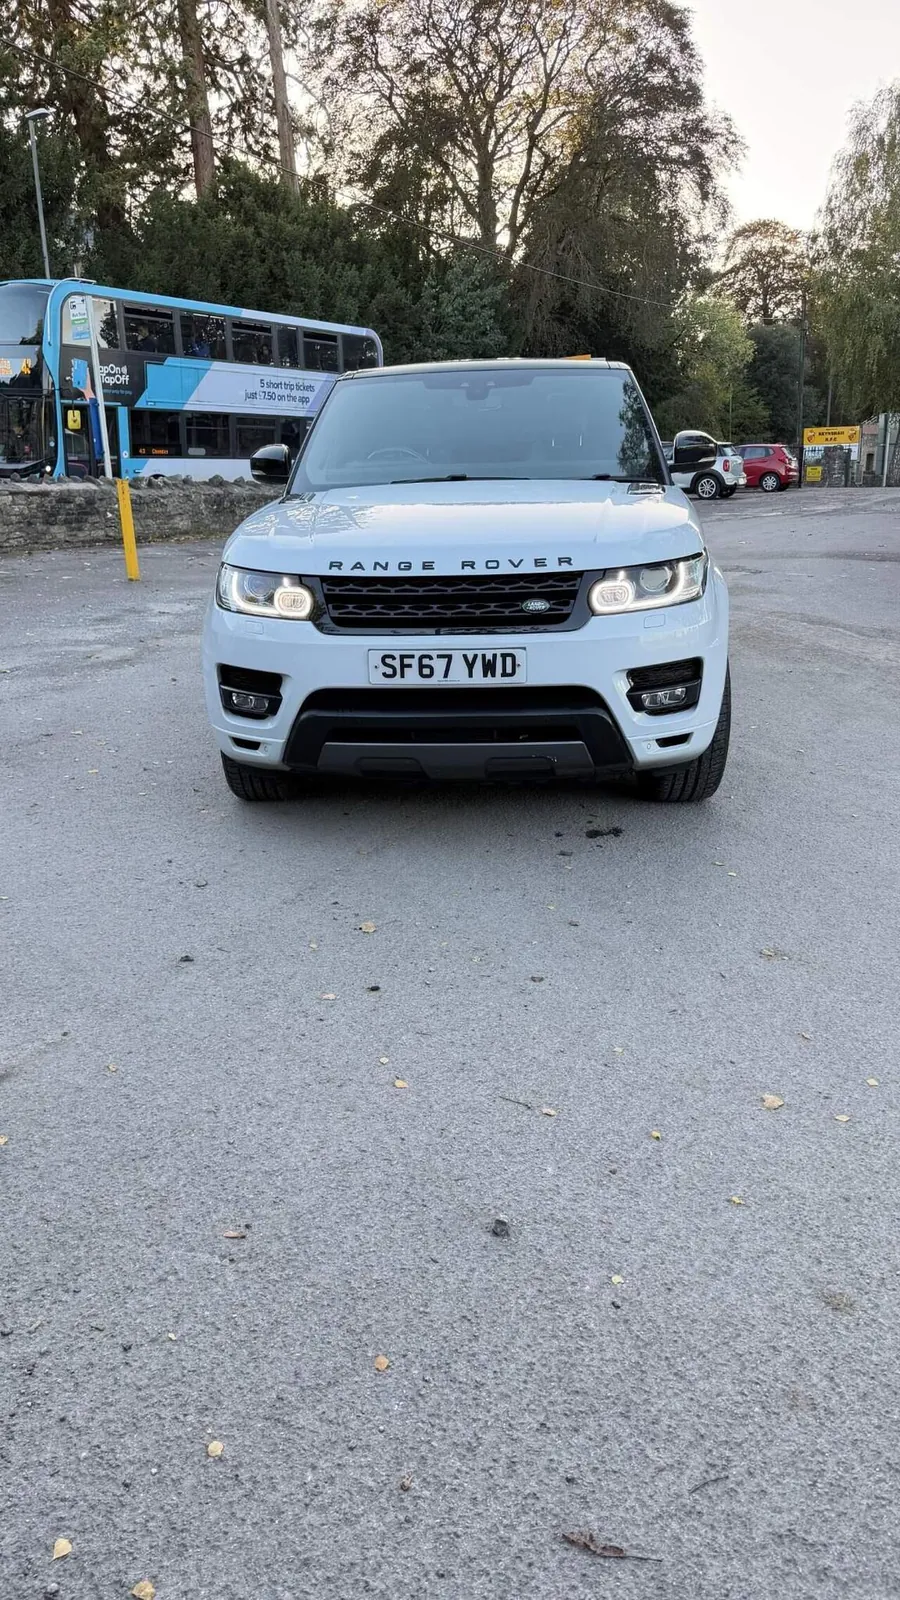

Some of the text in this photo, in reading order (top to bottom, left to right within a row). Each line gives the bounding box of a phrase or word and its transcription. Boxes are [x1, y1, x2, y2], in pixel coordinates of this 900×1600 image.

[99, 364, 121, 375] apOn
[260, 379, 316, 392] 5 short trip tickets
[244, 390, 258, 401] just
[286, 393, 297, 402] the
[298, 396, 310, 405] app
[328, 556, 574, 571] RANGE ROVER
[380, 652, 517, 679] SF67 YWD
